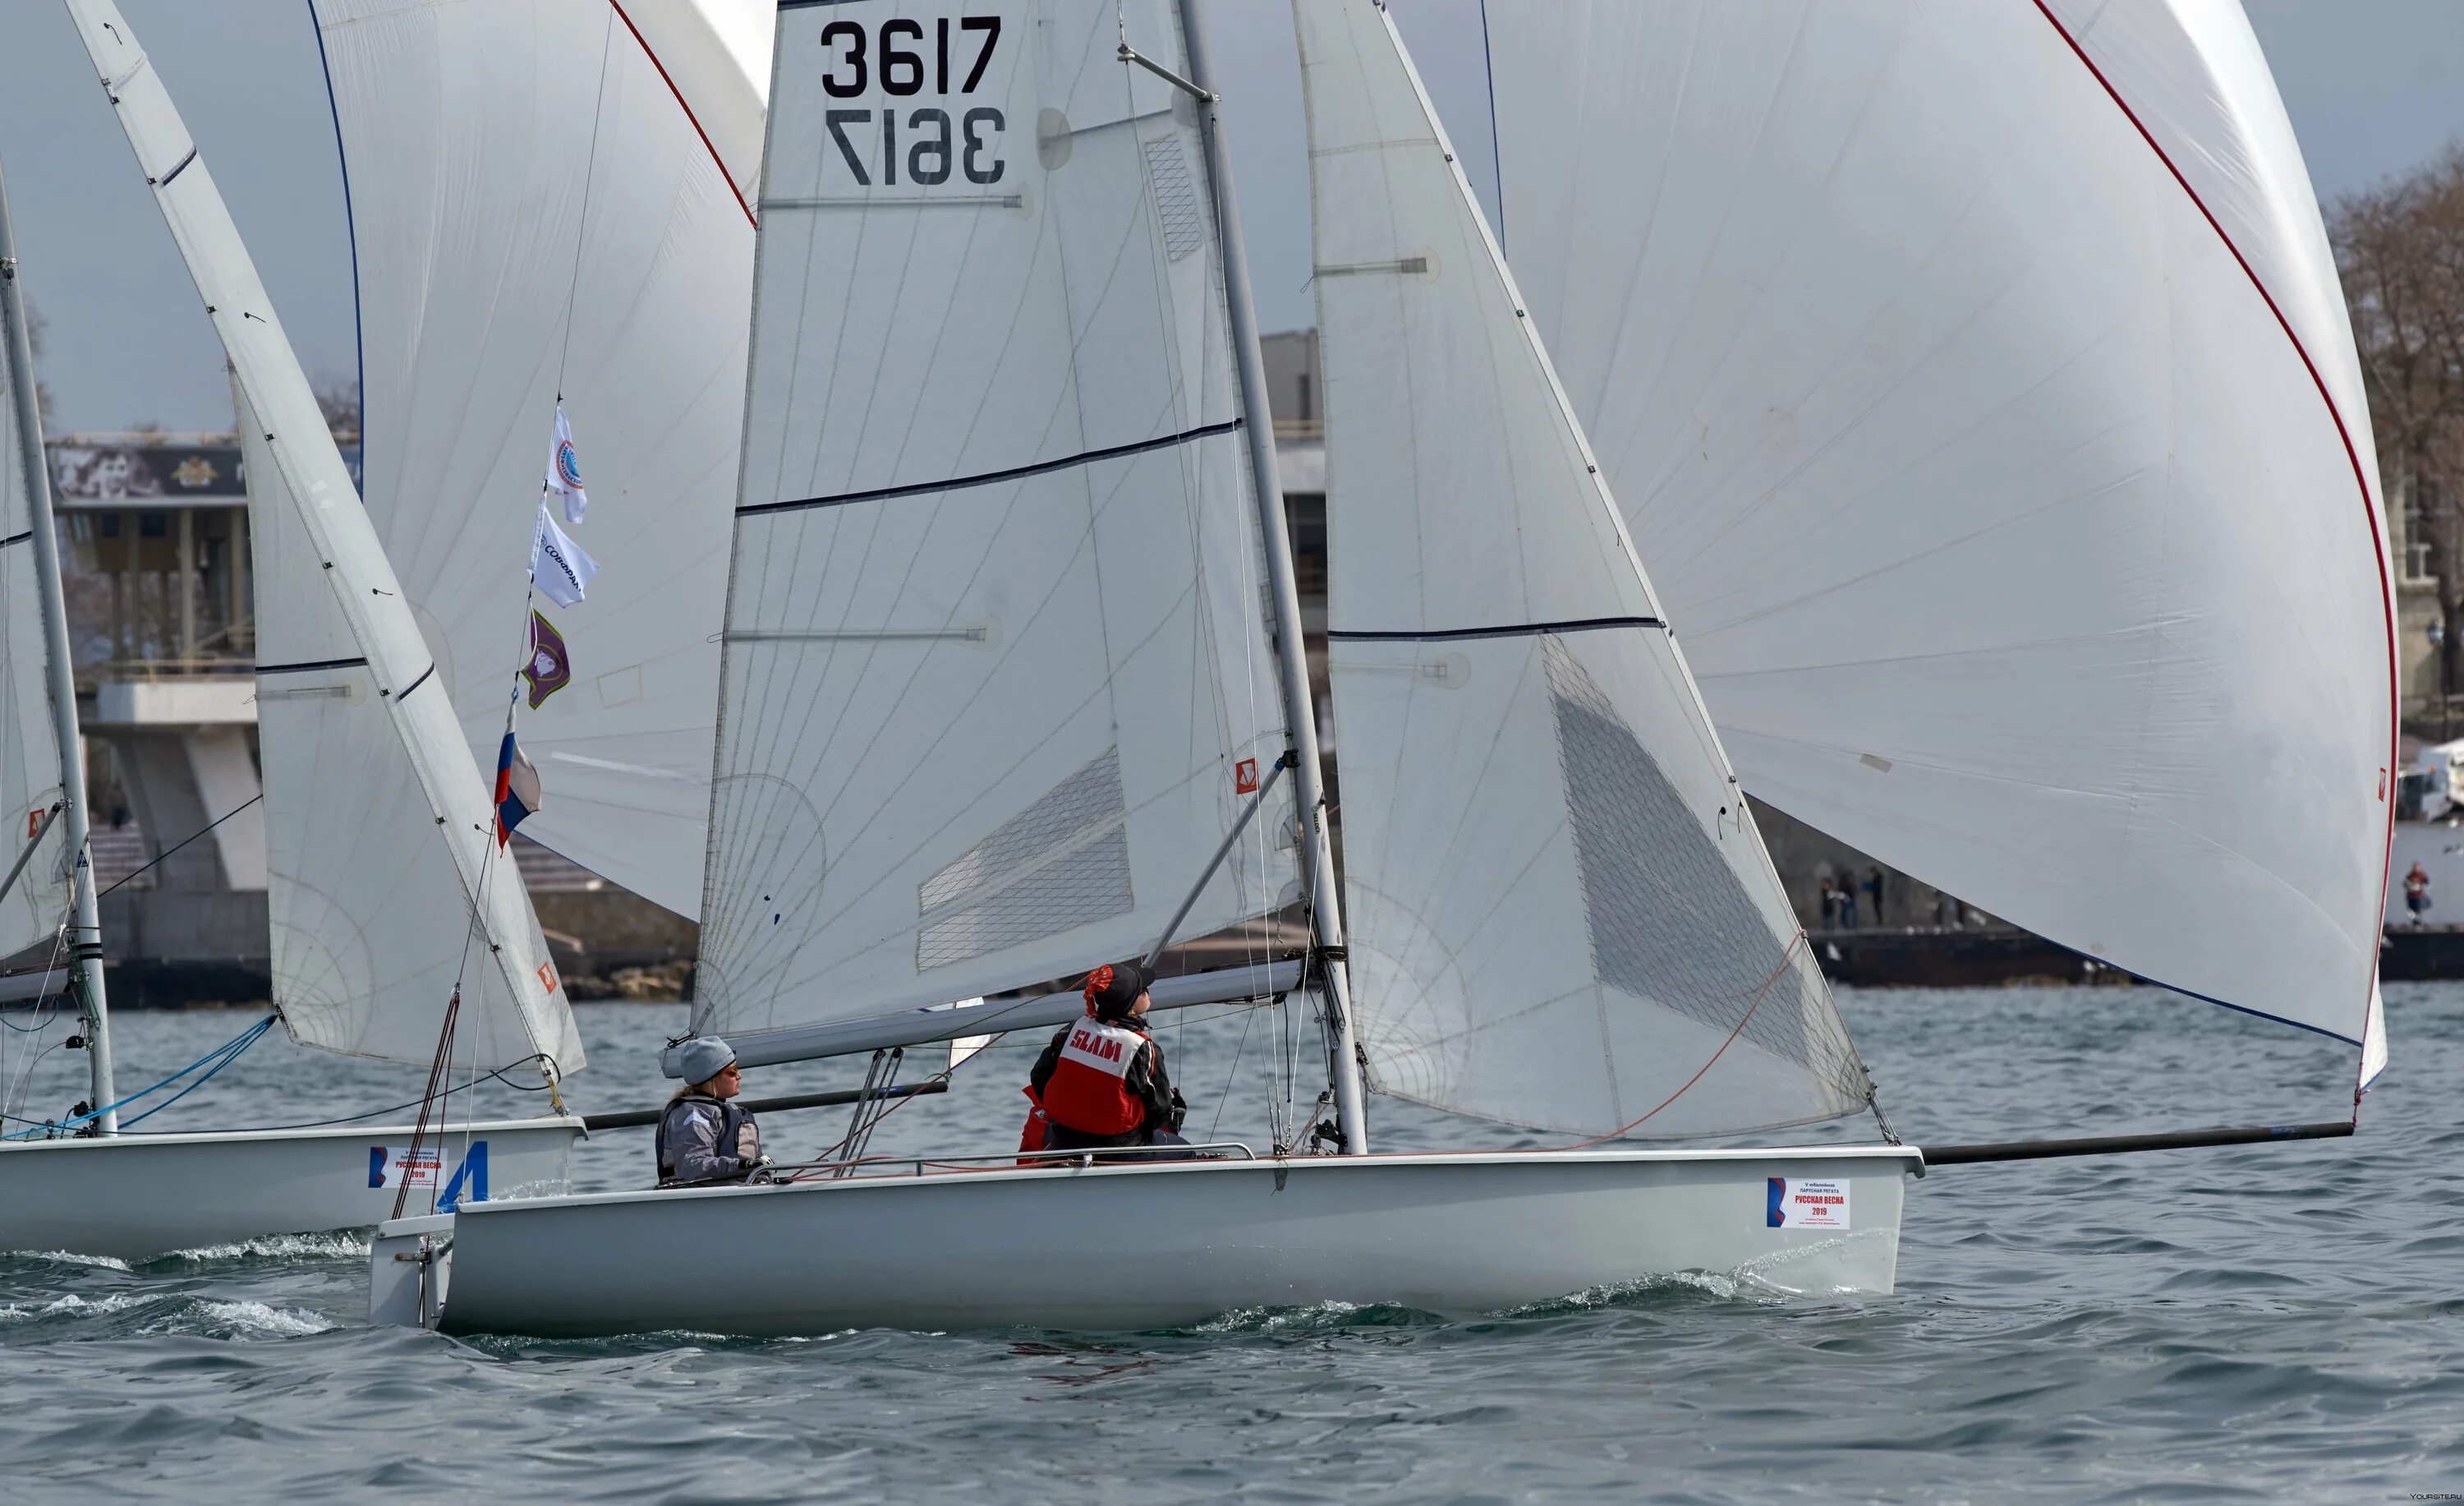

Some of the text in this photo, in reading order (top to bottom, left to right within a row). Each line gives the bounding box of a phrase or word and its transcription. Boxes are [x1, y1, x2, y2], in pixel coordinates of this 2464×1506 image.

[821, 16, 1000, 98] 3617
[1069, 1029, 1123, 1063] SLAM
[1795, 1195, 1844, 1204] РУССКАЯ ВЕСНА
[1812, 1207, 1827, 1216] 2019
